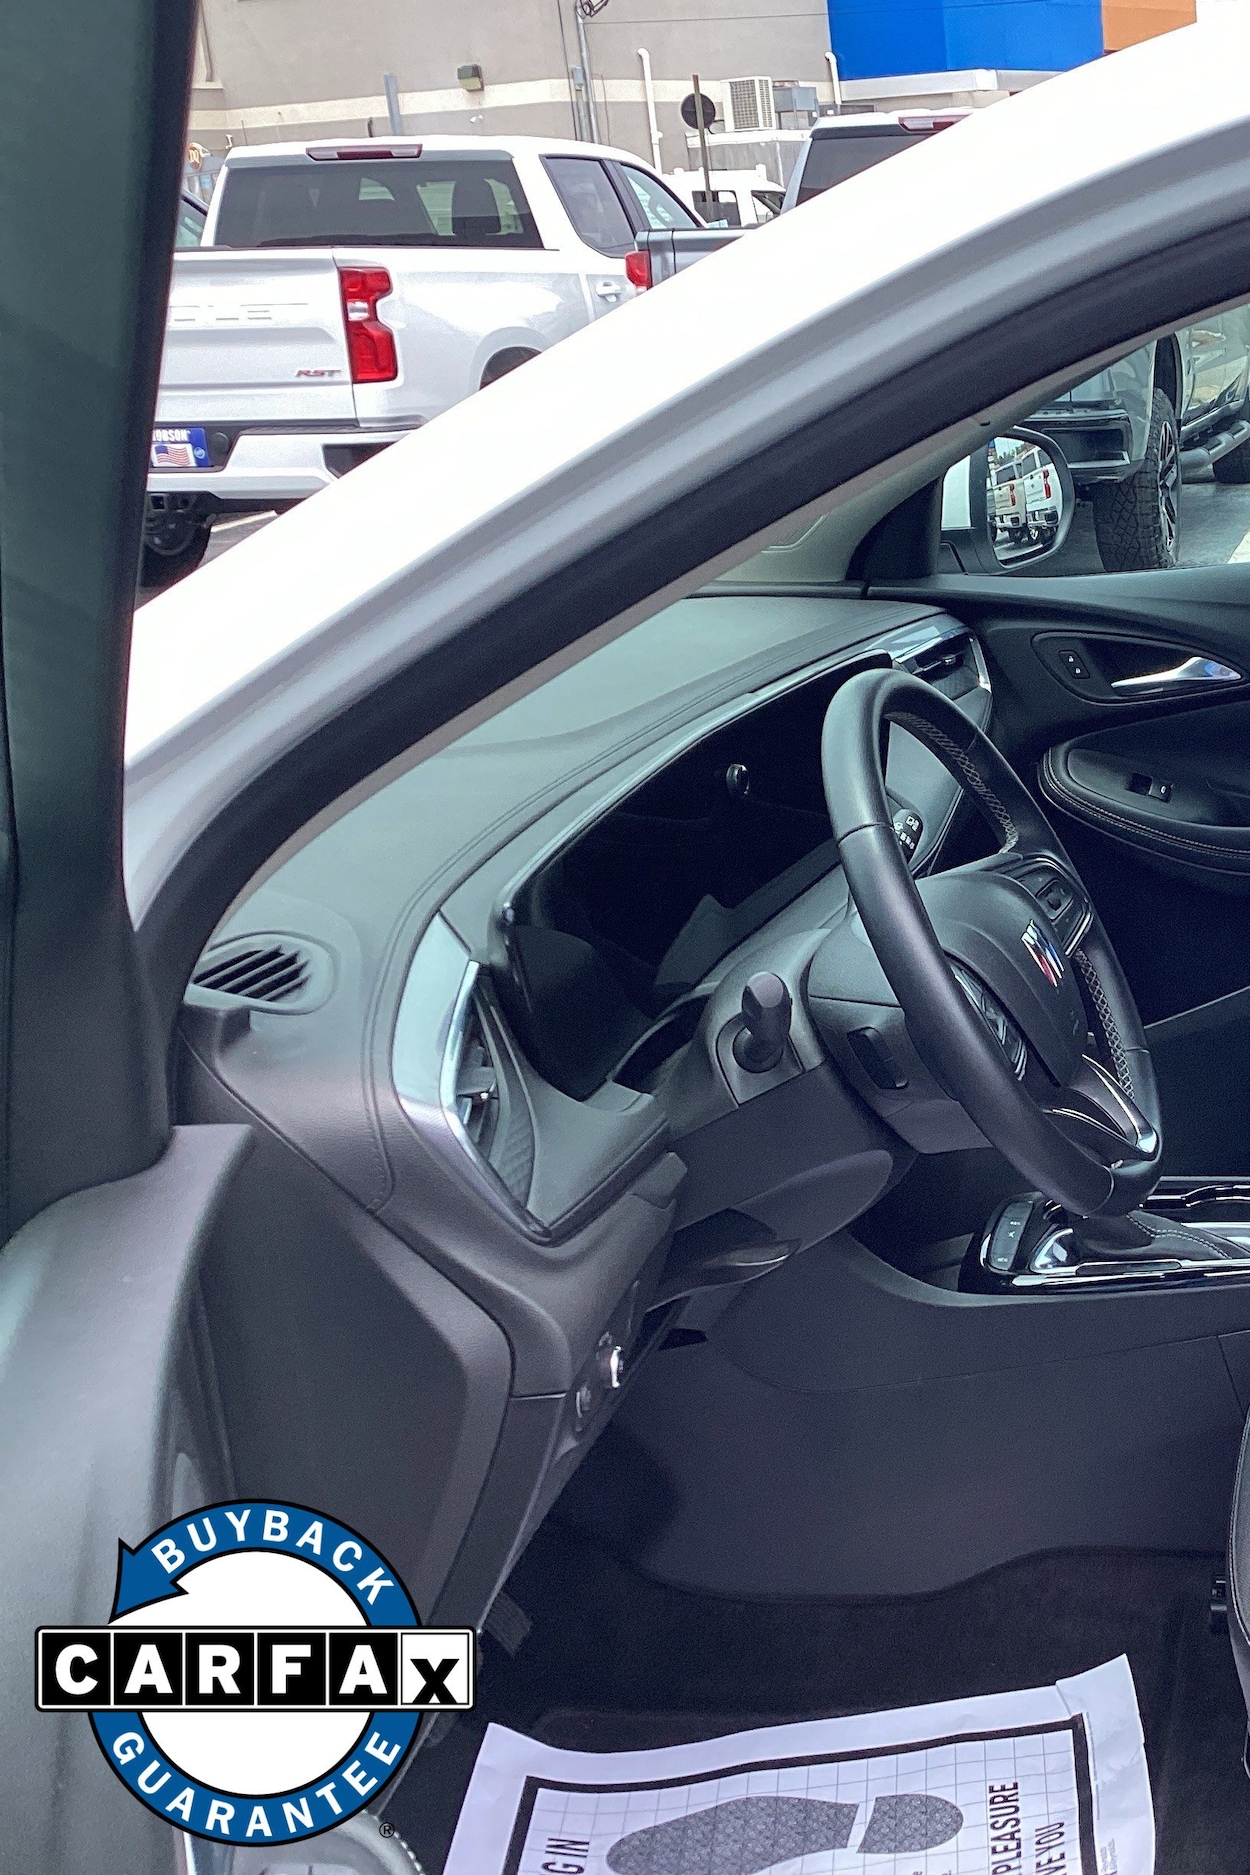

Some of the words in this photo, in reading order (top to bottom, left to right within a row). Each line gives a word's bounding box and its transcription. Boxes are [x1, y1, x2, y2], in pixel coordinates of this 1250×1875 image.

[295, 369, 342, 378] RST
[988, 1782, 1022, 1875] PLEASURE
[1034, 1821, 1065, 1858] YOU
[544, 1837, 590, 1858] IN
